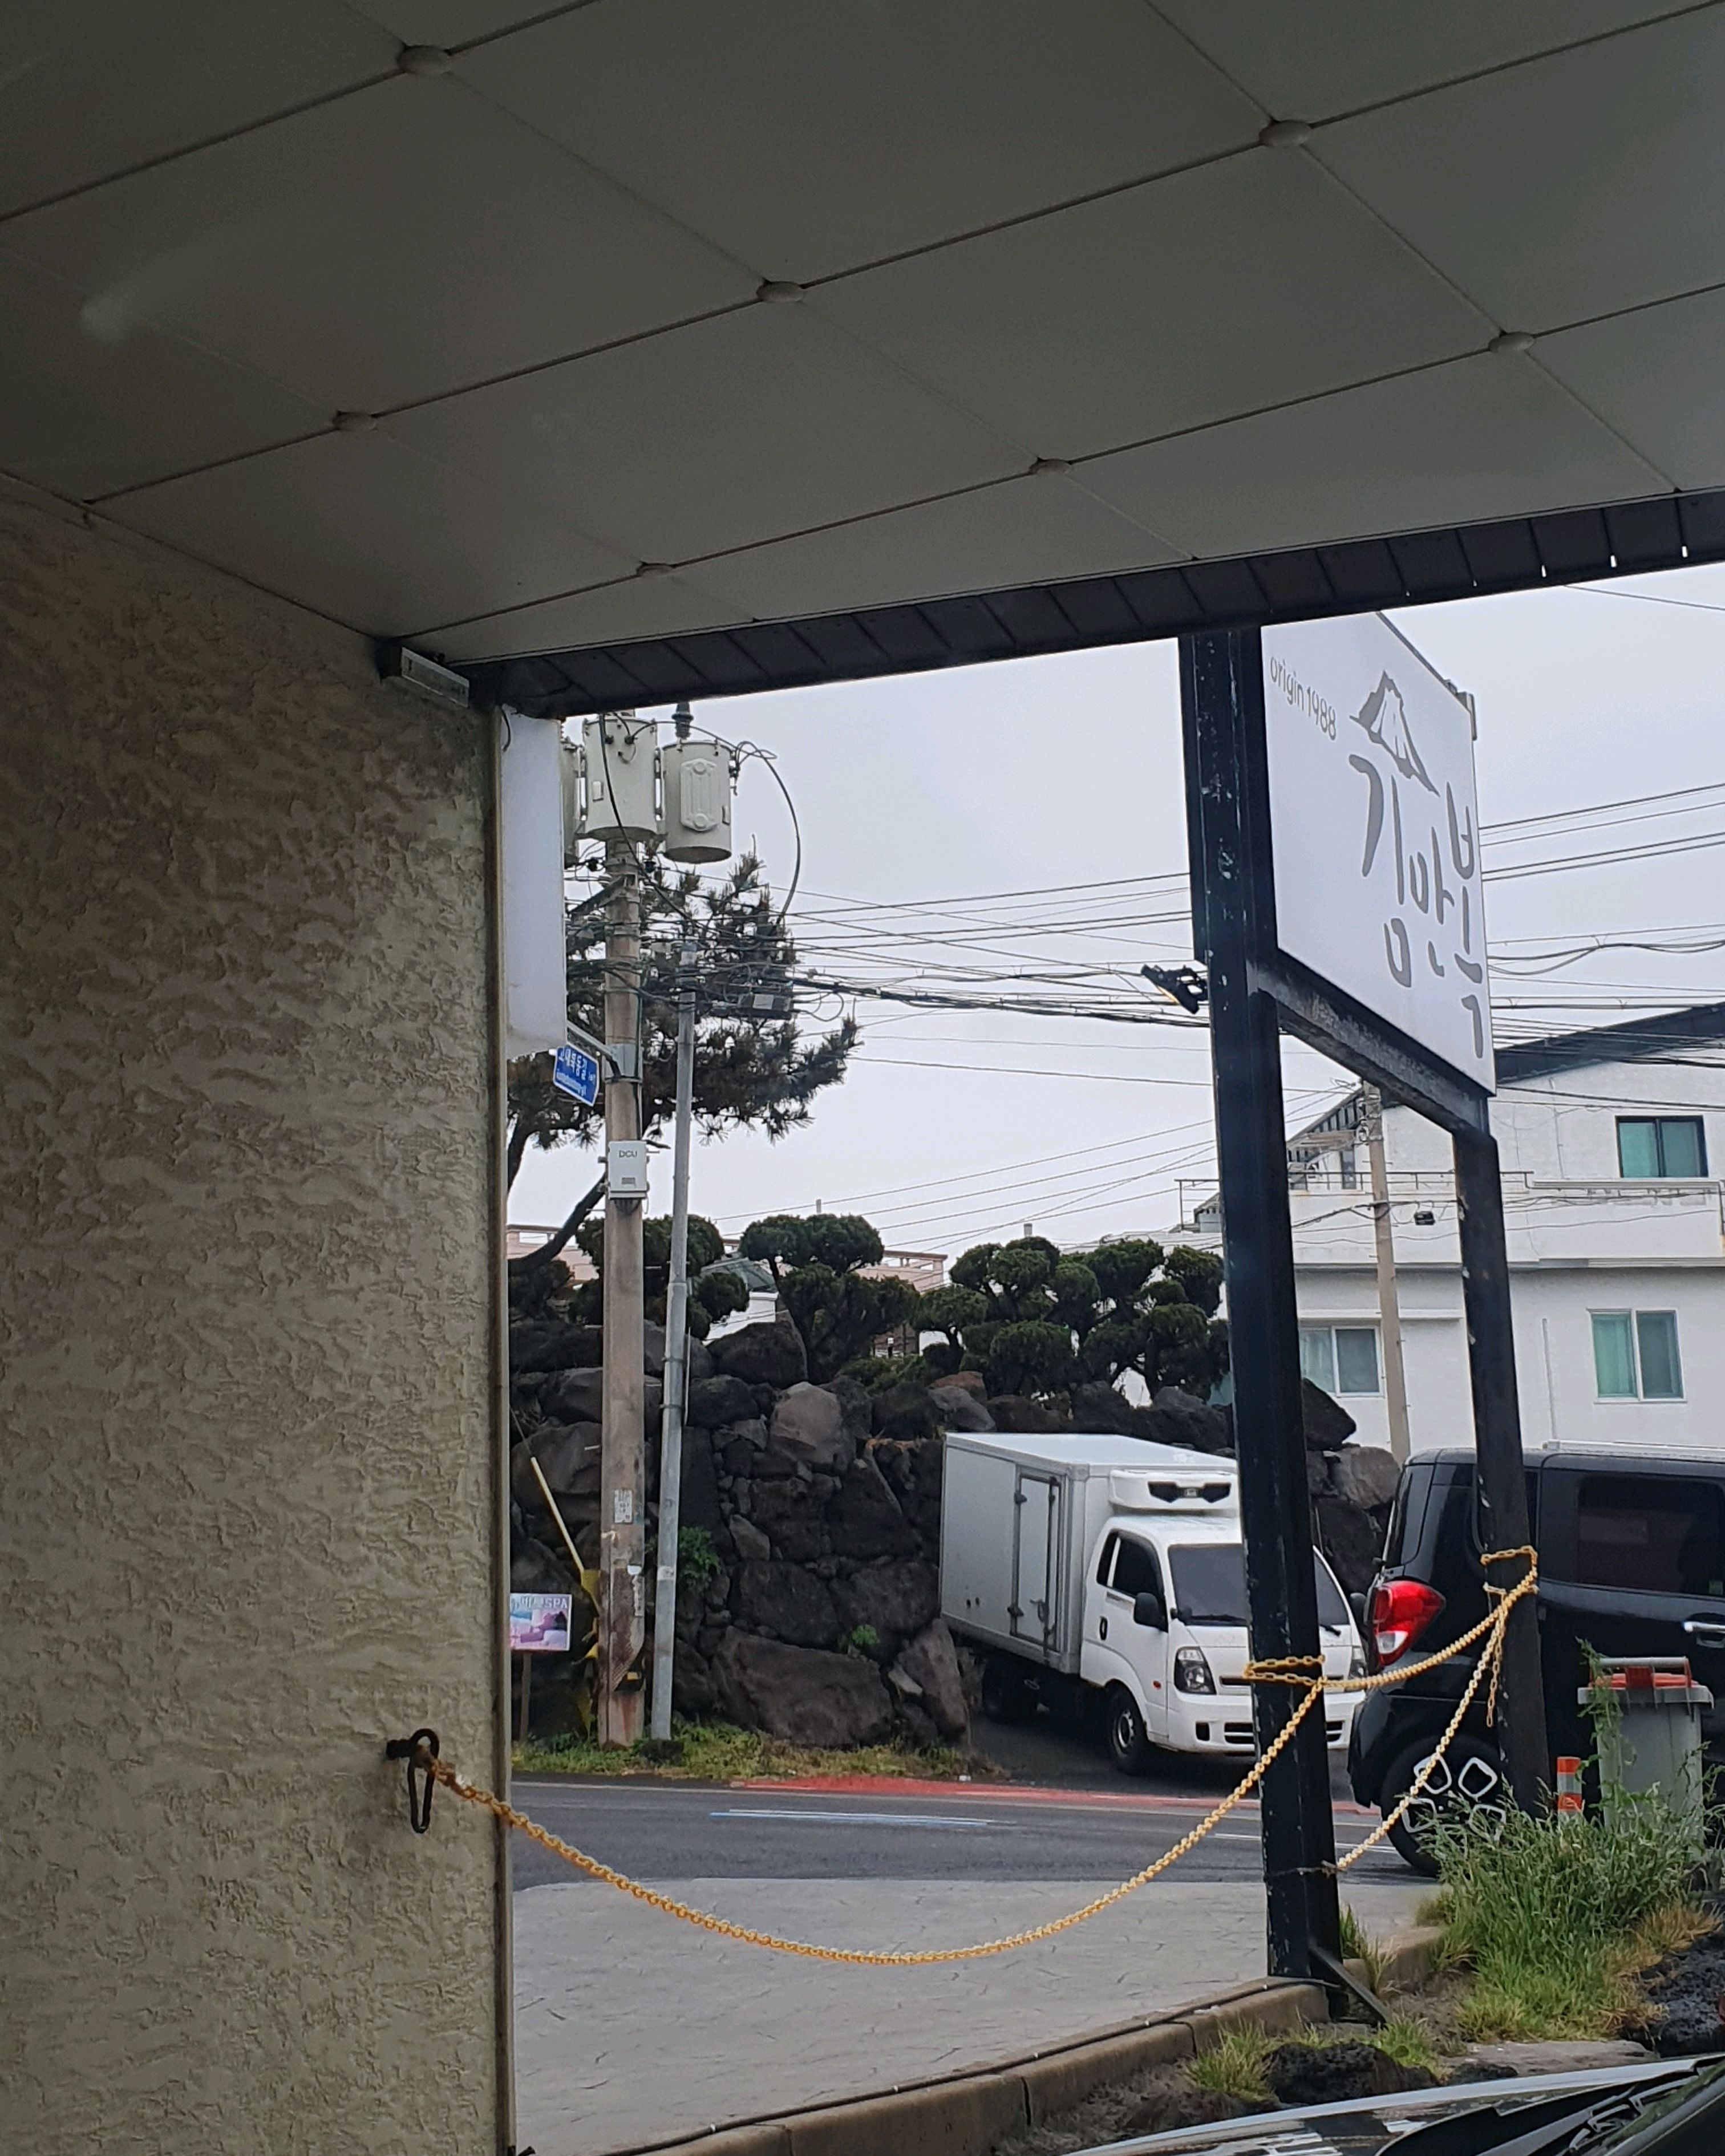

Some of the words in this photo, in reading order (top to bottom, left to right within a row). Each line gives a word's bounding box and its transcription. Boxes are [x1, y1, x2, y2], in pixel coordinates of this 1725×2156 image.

[1269, 654, 1305, 712] origin
[1306, 687, 1337, 741] 1988
[545, 1597, 568, 1608] SPA
